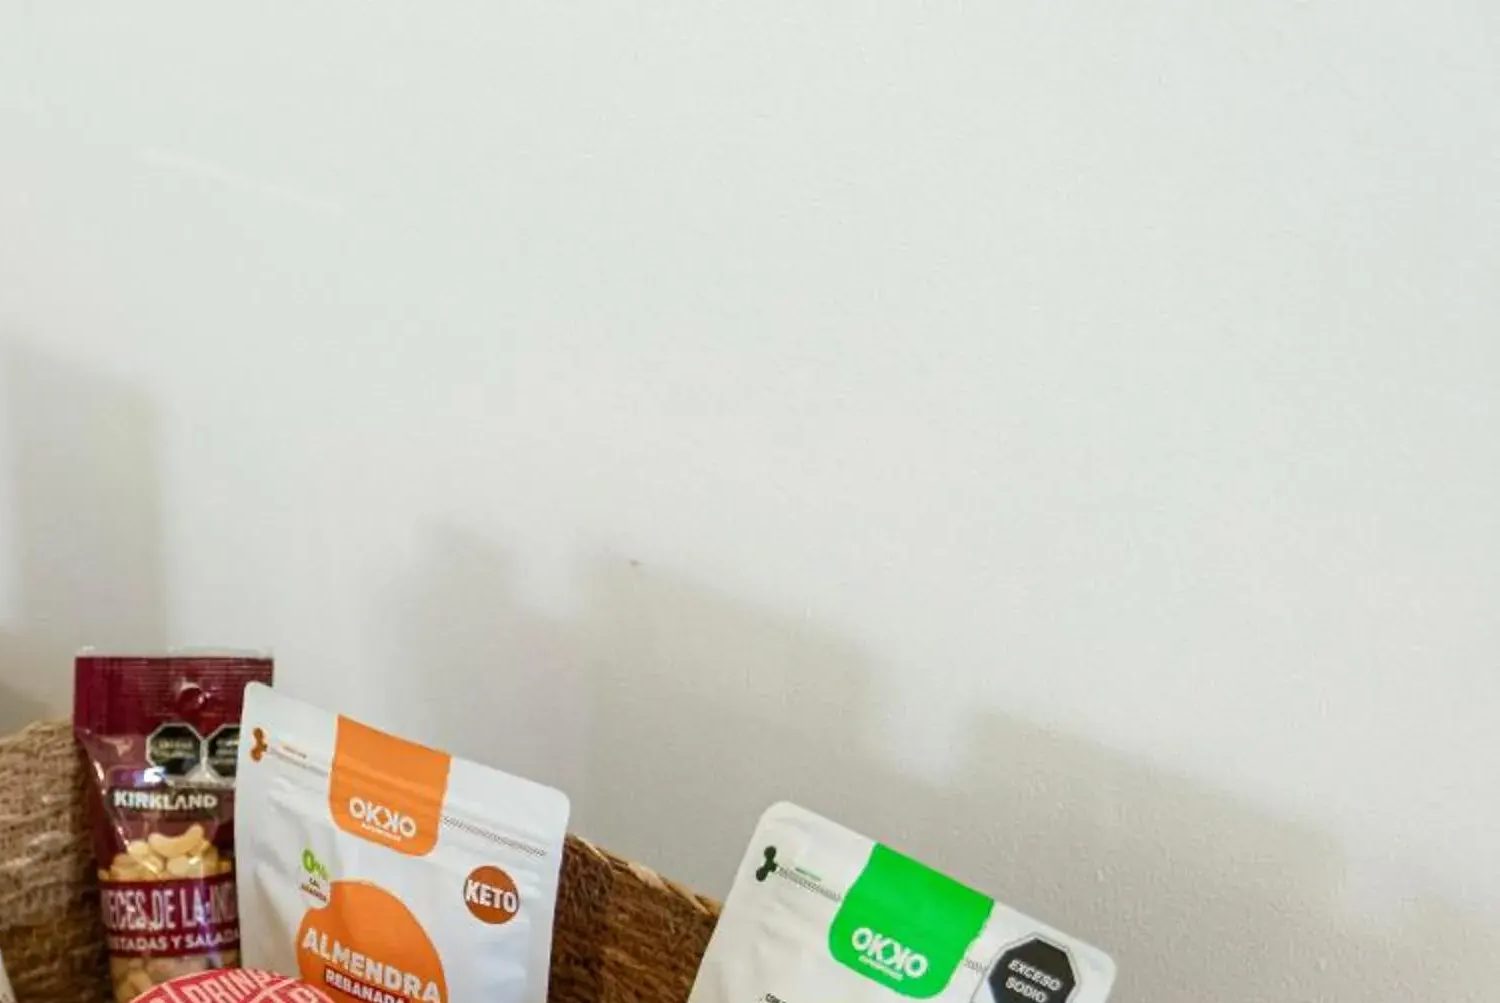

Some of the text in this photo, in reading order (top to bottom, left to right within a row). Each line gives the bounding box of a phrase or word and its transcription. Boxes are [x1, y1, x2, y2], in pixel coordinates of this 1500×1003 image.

[114, 790, 218, 810] KIRKLAND
[152, 888, 176, 930] DE
[180, 886, 206, 928] LA
[465, 878, 520, 914] KETO
[170, 935, 183, 949] Y
[1007, 959, 1063, 992] EXCESO
